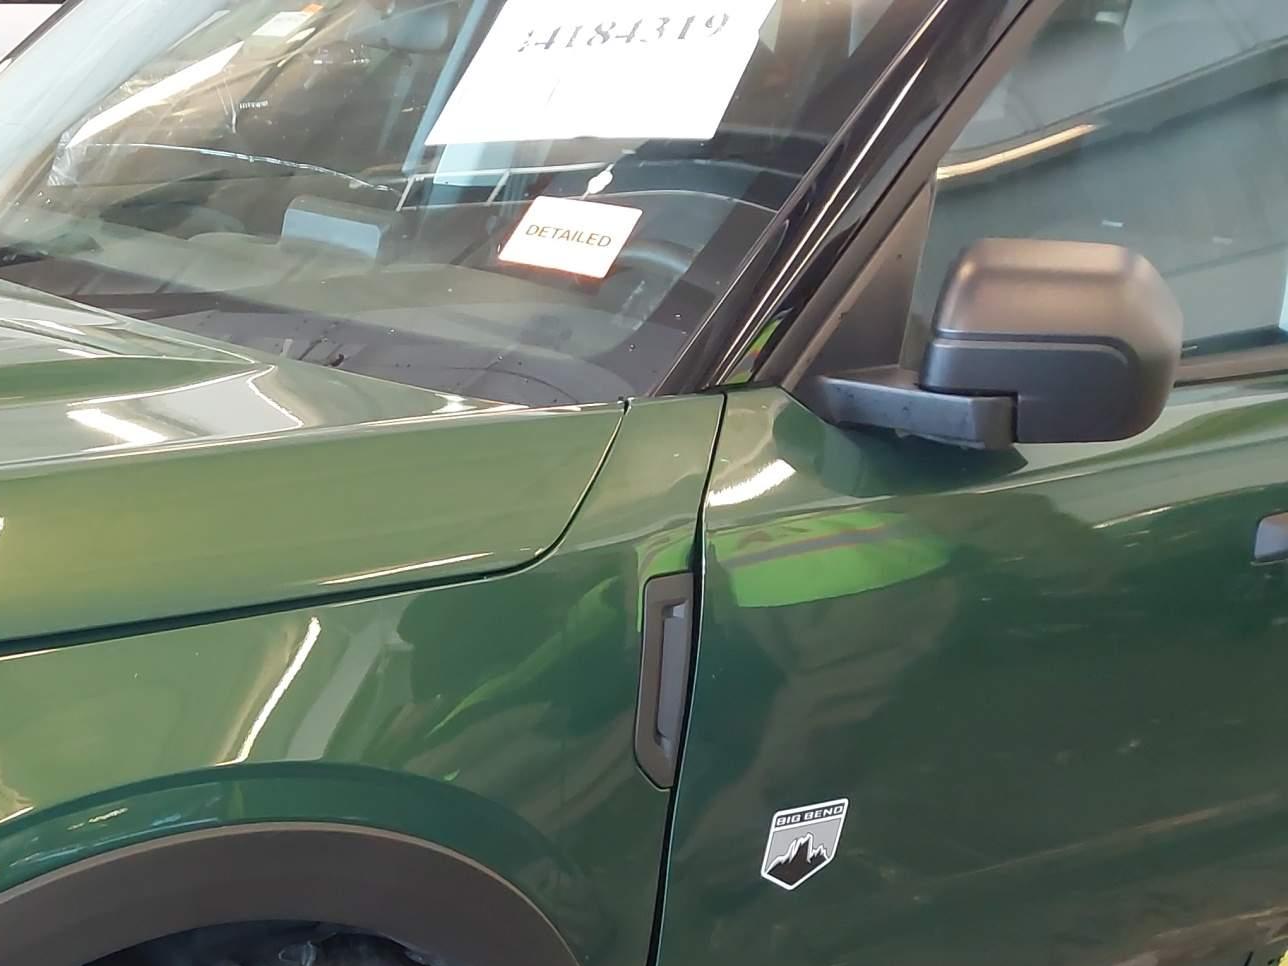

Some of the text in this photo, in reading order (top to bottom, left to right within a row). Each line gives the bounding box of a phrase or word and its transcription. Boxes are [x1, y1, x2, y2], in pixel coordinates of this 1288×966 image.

[525, 224, 612, 247] DETAILED
[777, 806, 843, 826] BIG BEND
